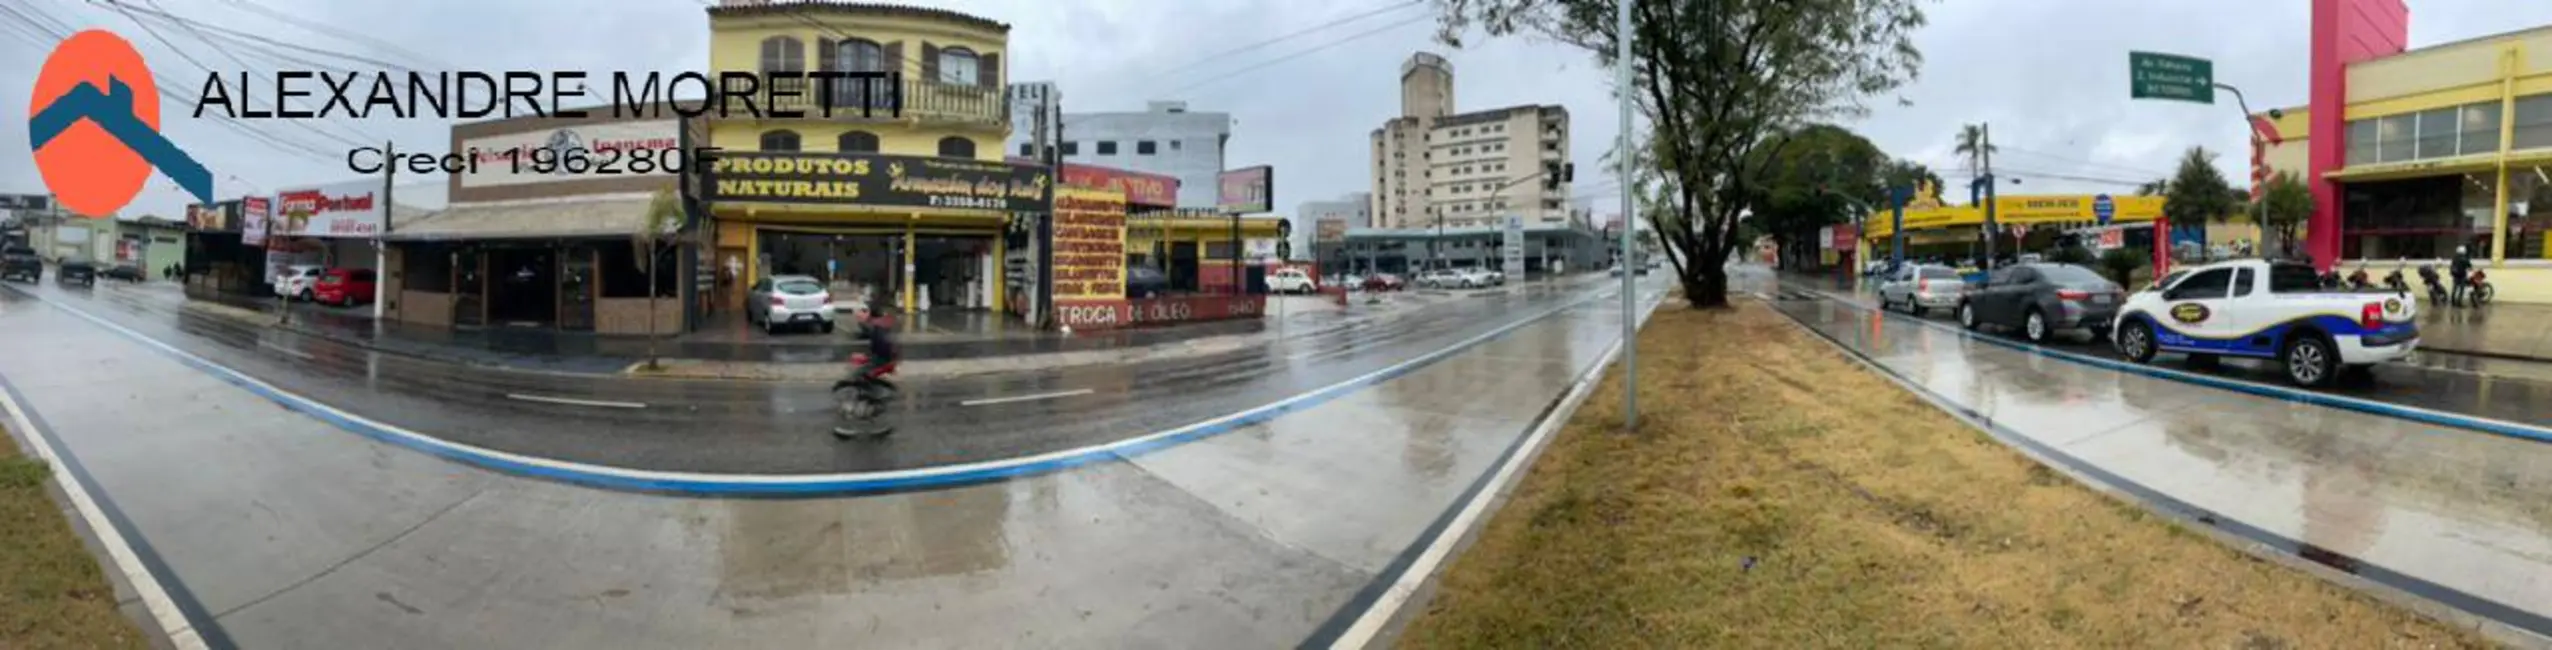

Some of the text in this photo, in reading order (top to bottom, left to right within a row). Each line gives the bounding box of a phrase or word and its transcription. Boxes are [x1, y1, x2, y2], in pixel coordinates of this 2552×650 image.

[711, 155, 870, 176] PRODUTOS
[717, 179, 860, 198] NATURAIS
[1058, 305, 1117, 325] TROCA
